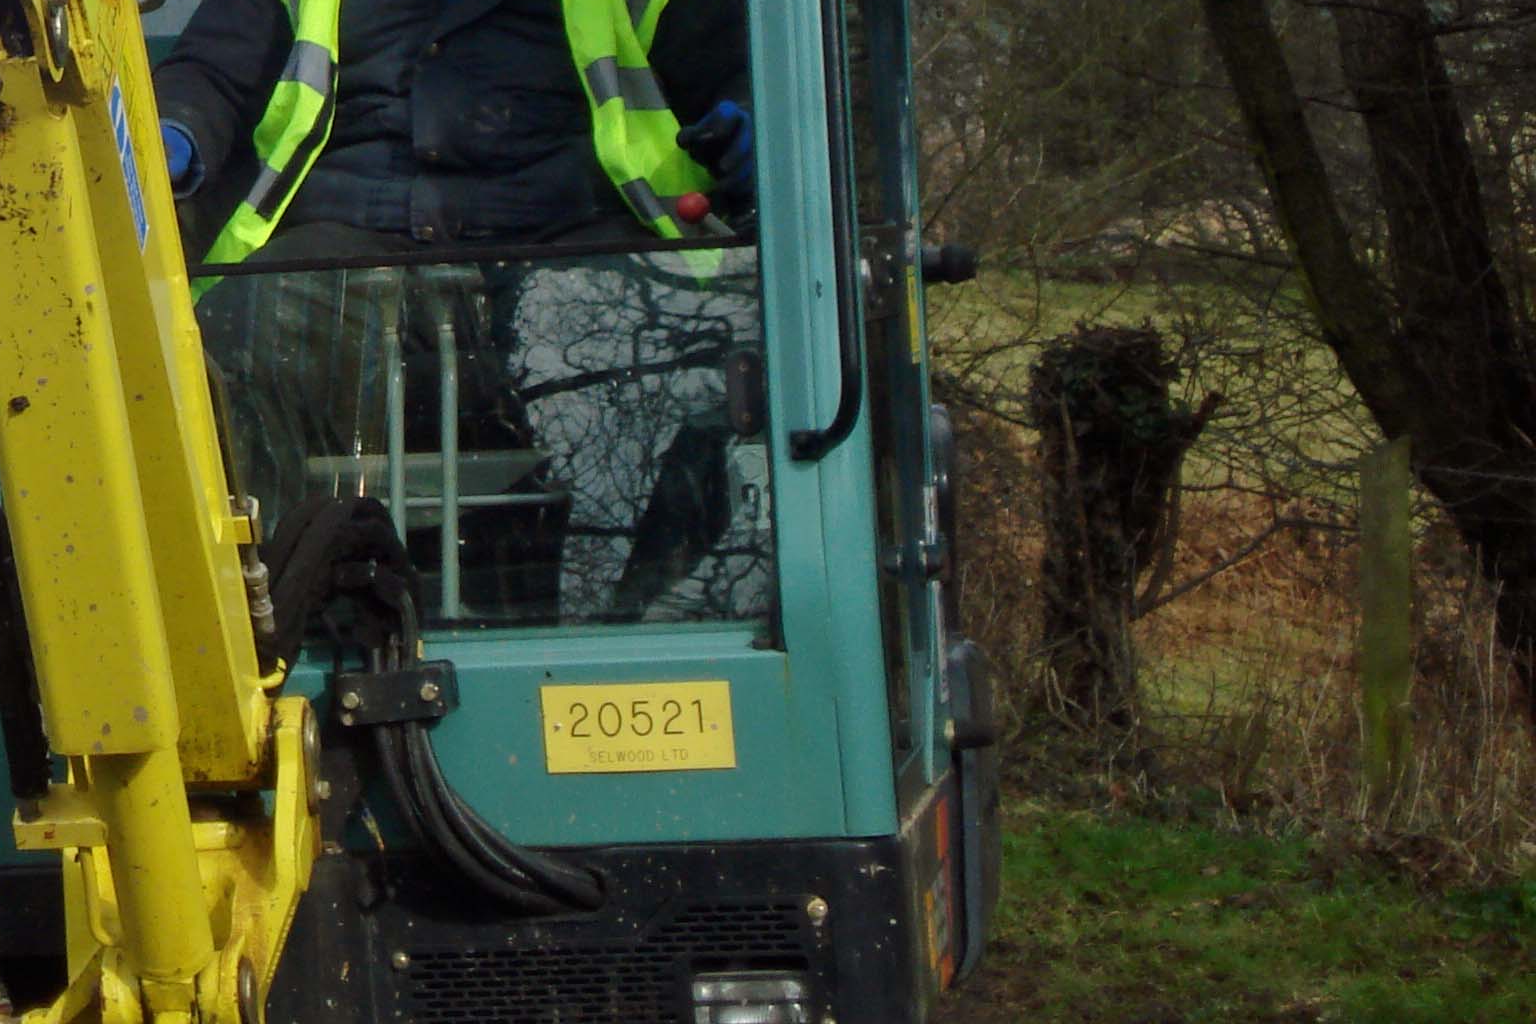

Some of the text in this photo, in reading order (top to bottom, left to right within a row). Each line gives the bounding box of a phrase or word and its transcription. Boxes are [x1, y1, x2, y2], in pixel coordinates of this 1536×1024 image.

[568, 698, 705, 739] 20521
[589, 747, 689, 765] SELWOOD LTD
